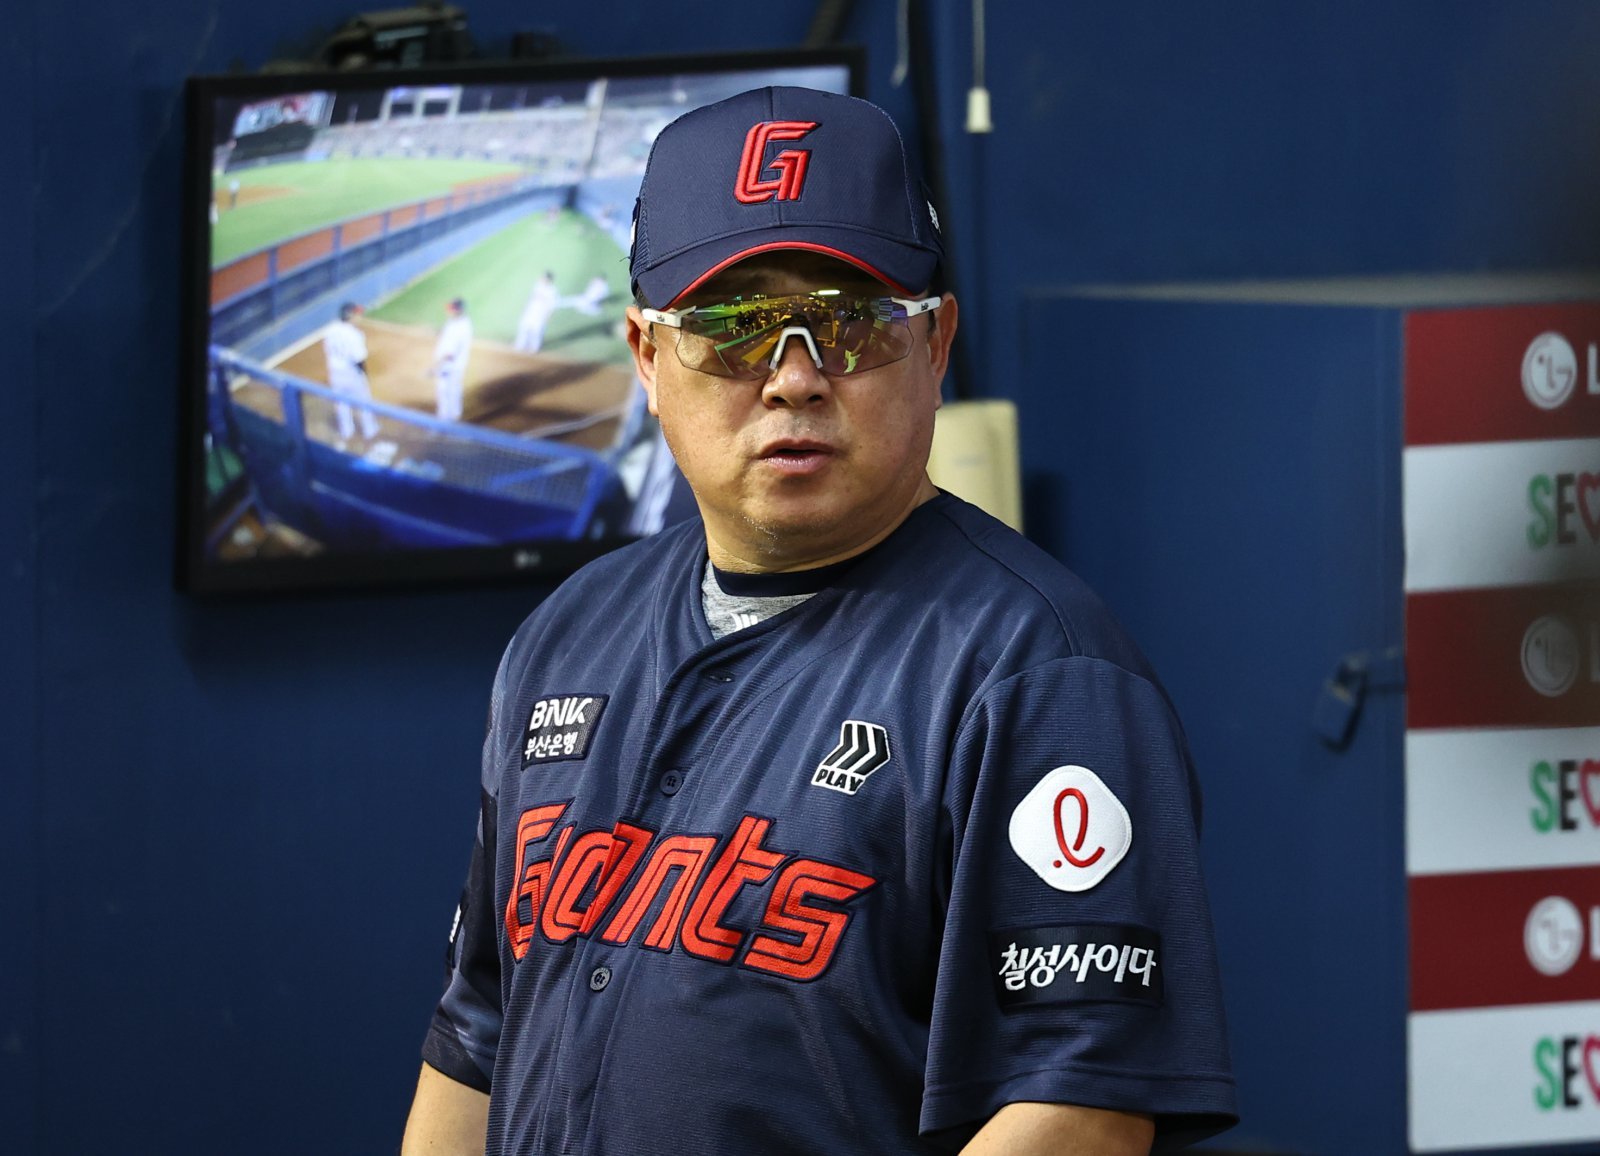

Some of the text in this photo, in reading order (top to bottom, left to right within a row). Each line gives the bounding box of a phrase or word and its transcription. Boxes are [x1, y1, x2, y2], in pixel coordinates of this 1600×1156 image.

[734, 121, 817, 204] G
[529, 697, 593, 731] BNK
[524, 732, 579, 760] 부산은행
[815, 768, 864, 792] PLAY
[504, 802, 879, 980] Giants
[998, 941, 1157, 991] 칠성사이다
